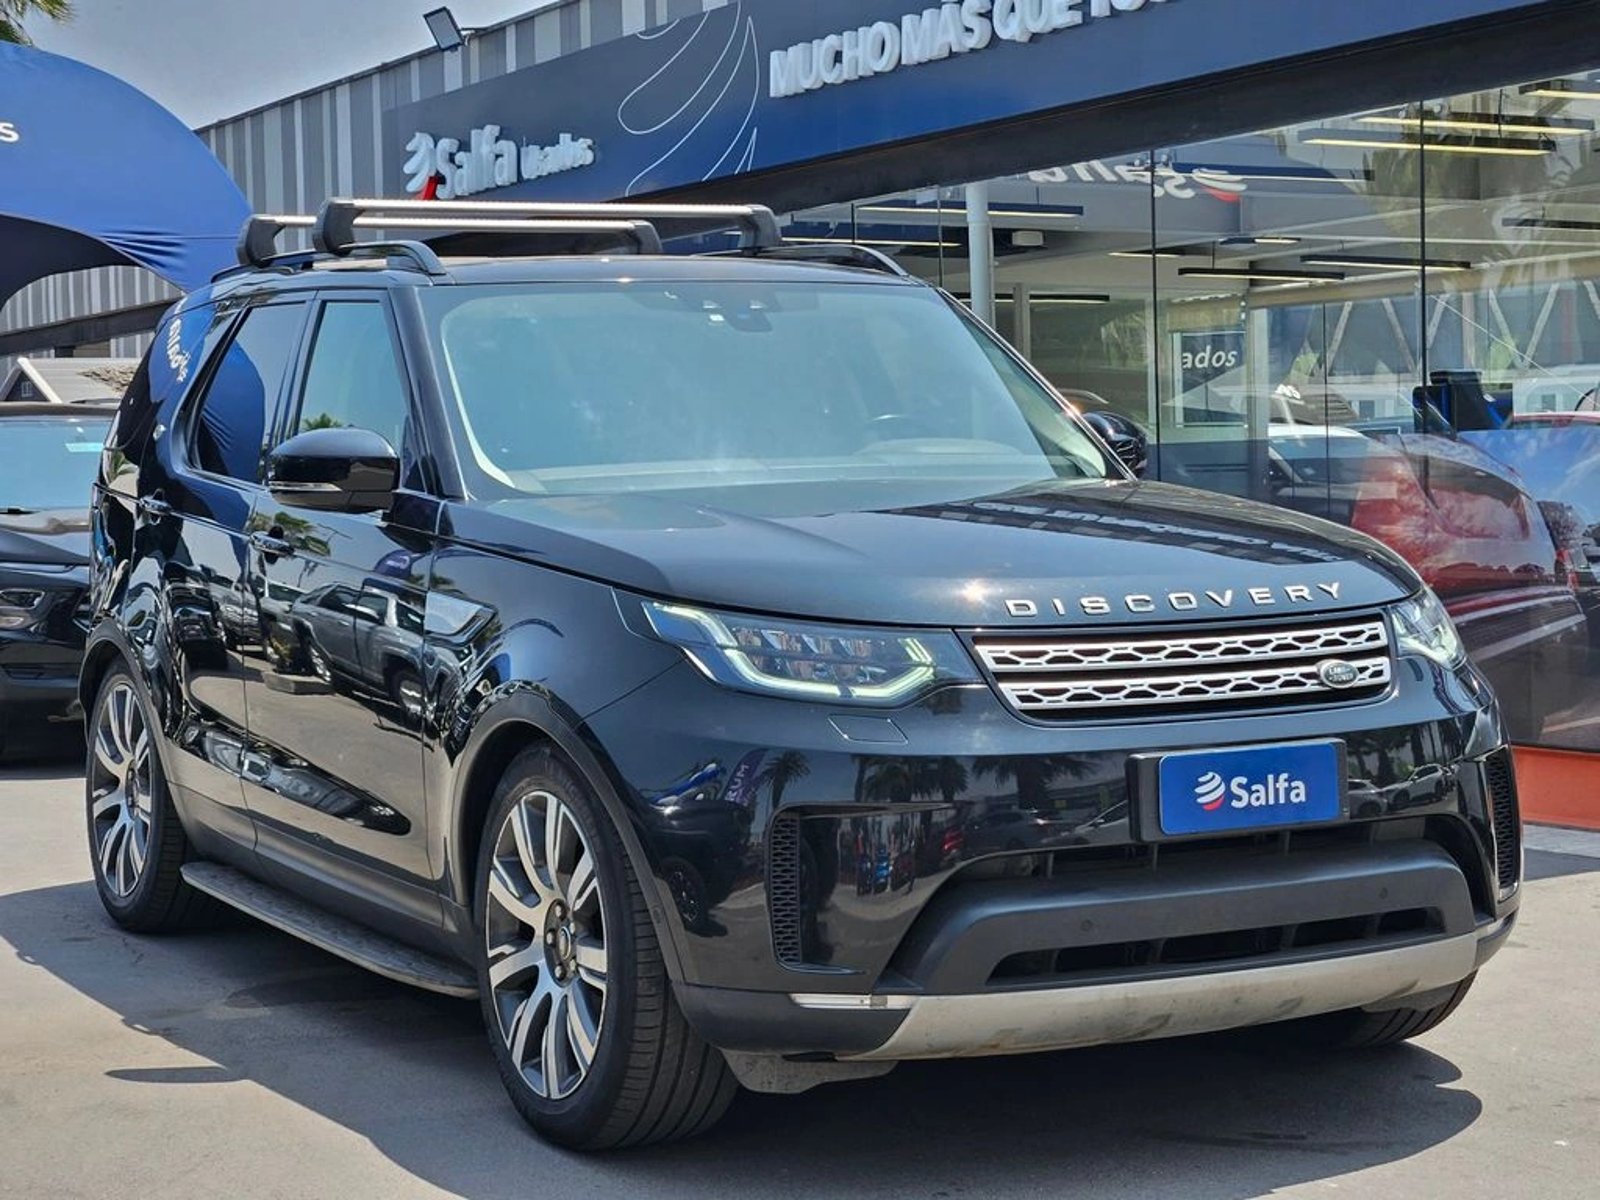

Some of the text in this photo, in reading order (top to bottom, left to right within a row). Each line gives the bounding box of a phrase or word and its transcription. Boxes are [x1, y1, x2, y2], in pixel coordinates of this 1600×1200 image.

[770, 21, 901, 97] MUCHO
[993, 0, 1083, 43] QUE
[436, 124, 518, 200] Salfa
[1005, 582, 1341, 617] DISCOVERY
[1230, 772, 1307, 809] Salfa
